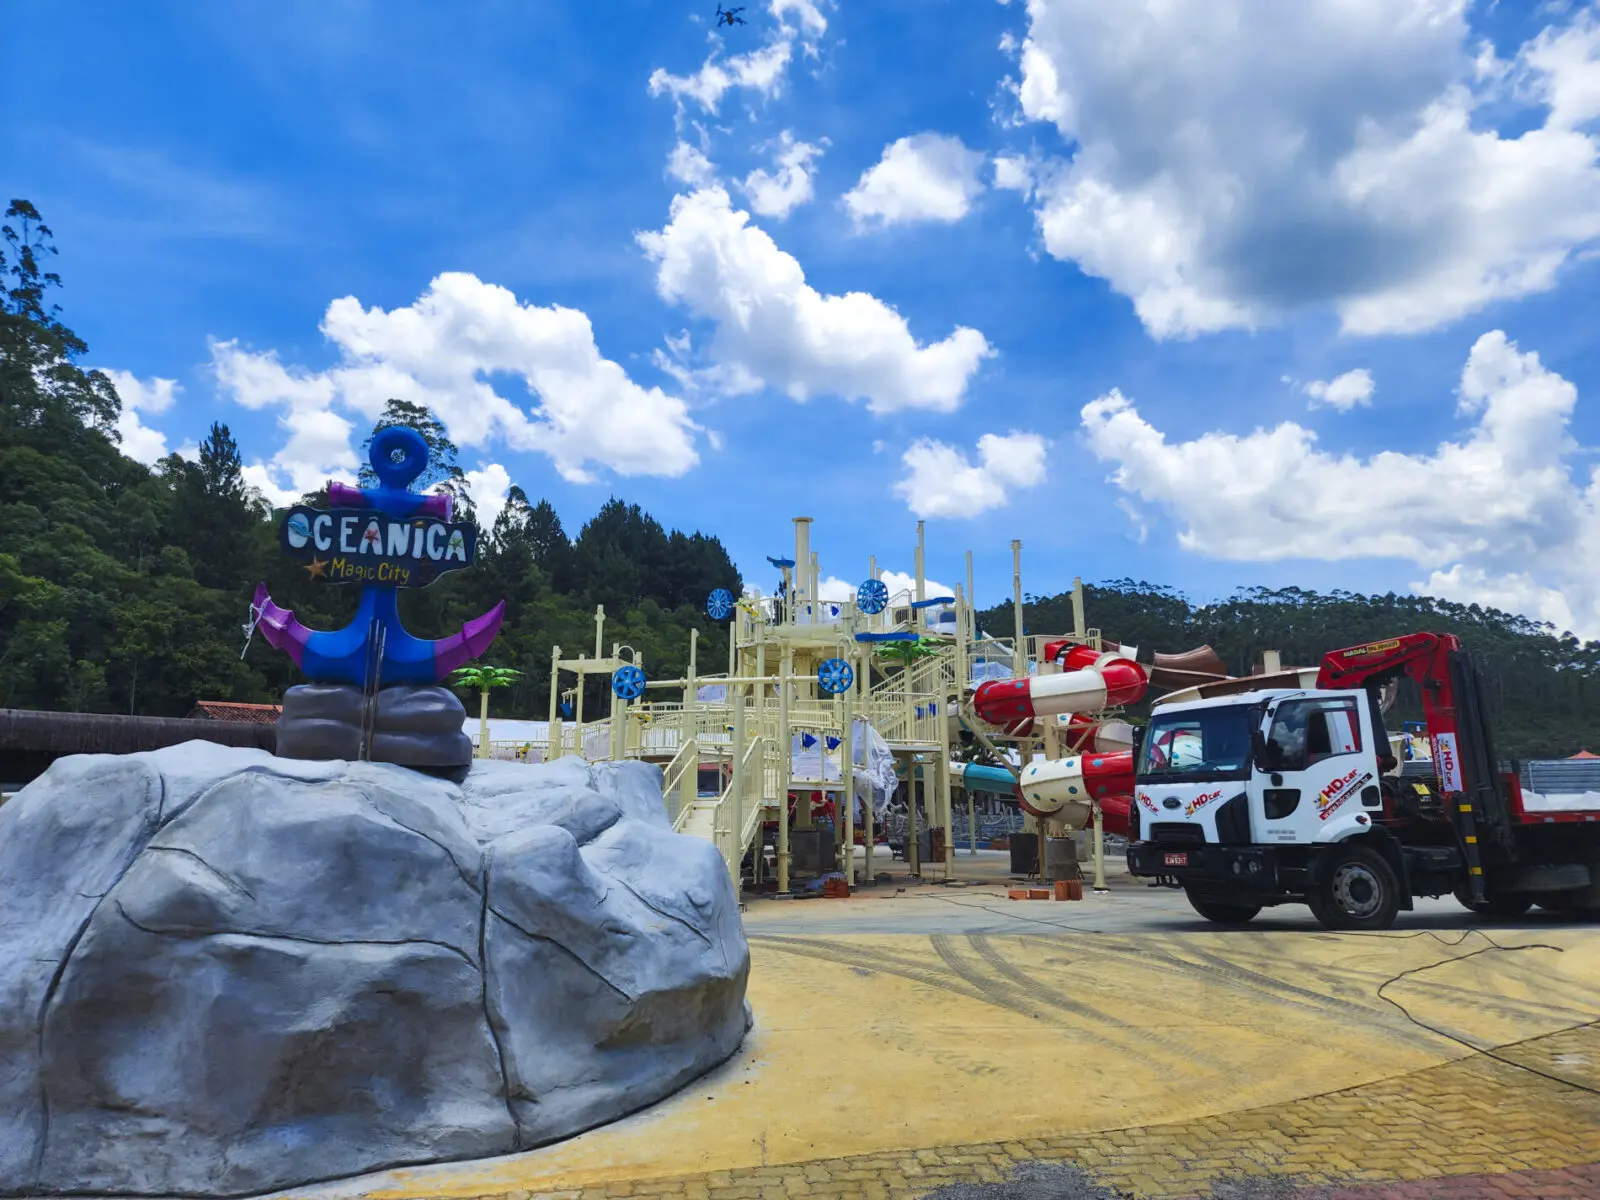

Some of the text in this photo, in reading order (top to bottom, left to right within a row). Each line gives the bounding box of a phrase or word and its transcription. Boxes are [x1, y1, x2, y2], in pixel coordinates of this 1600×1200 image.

[287, 513, 466, 562] OCEÂNICA
[330, 557, 410, 585] Magic City
